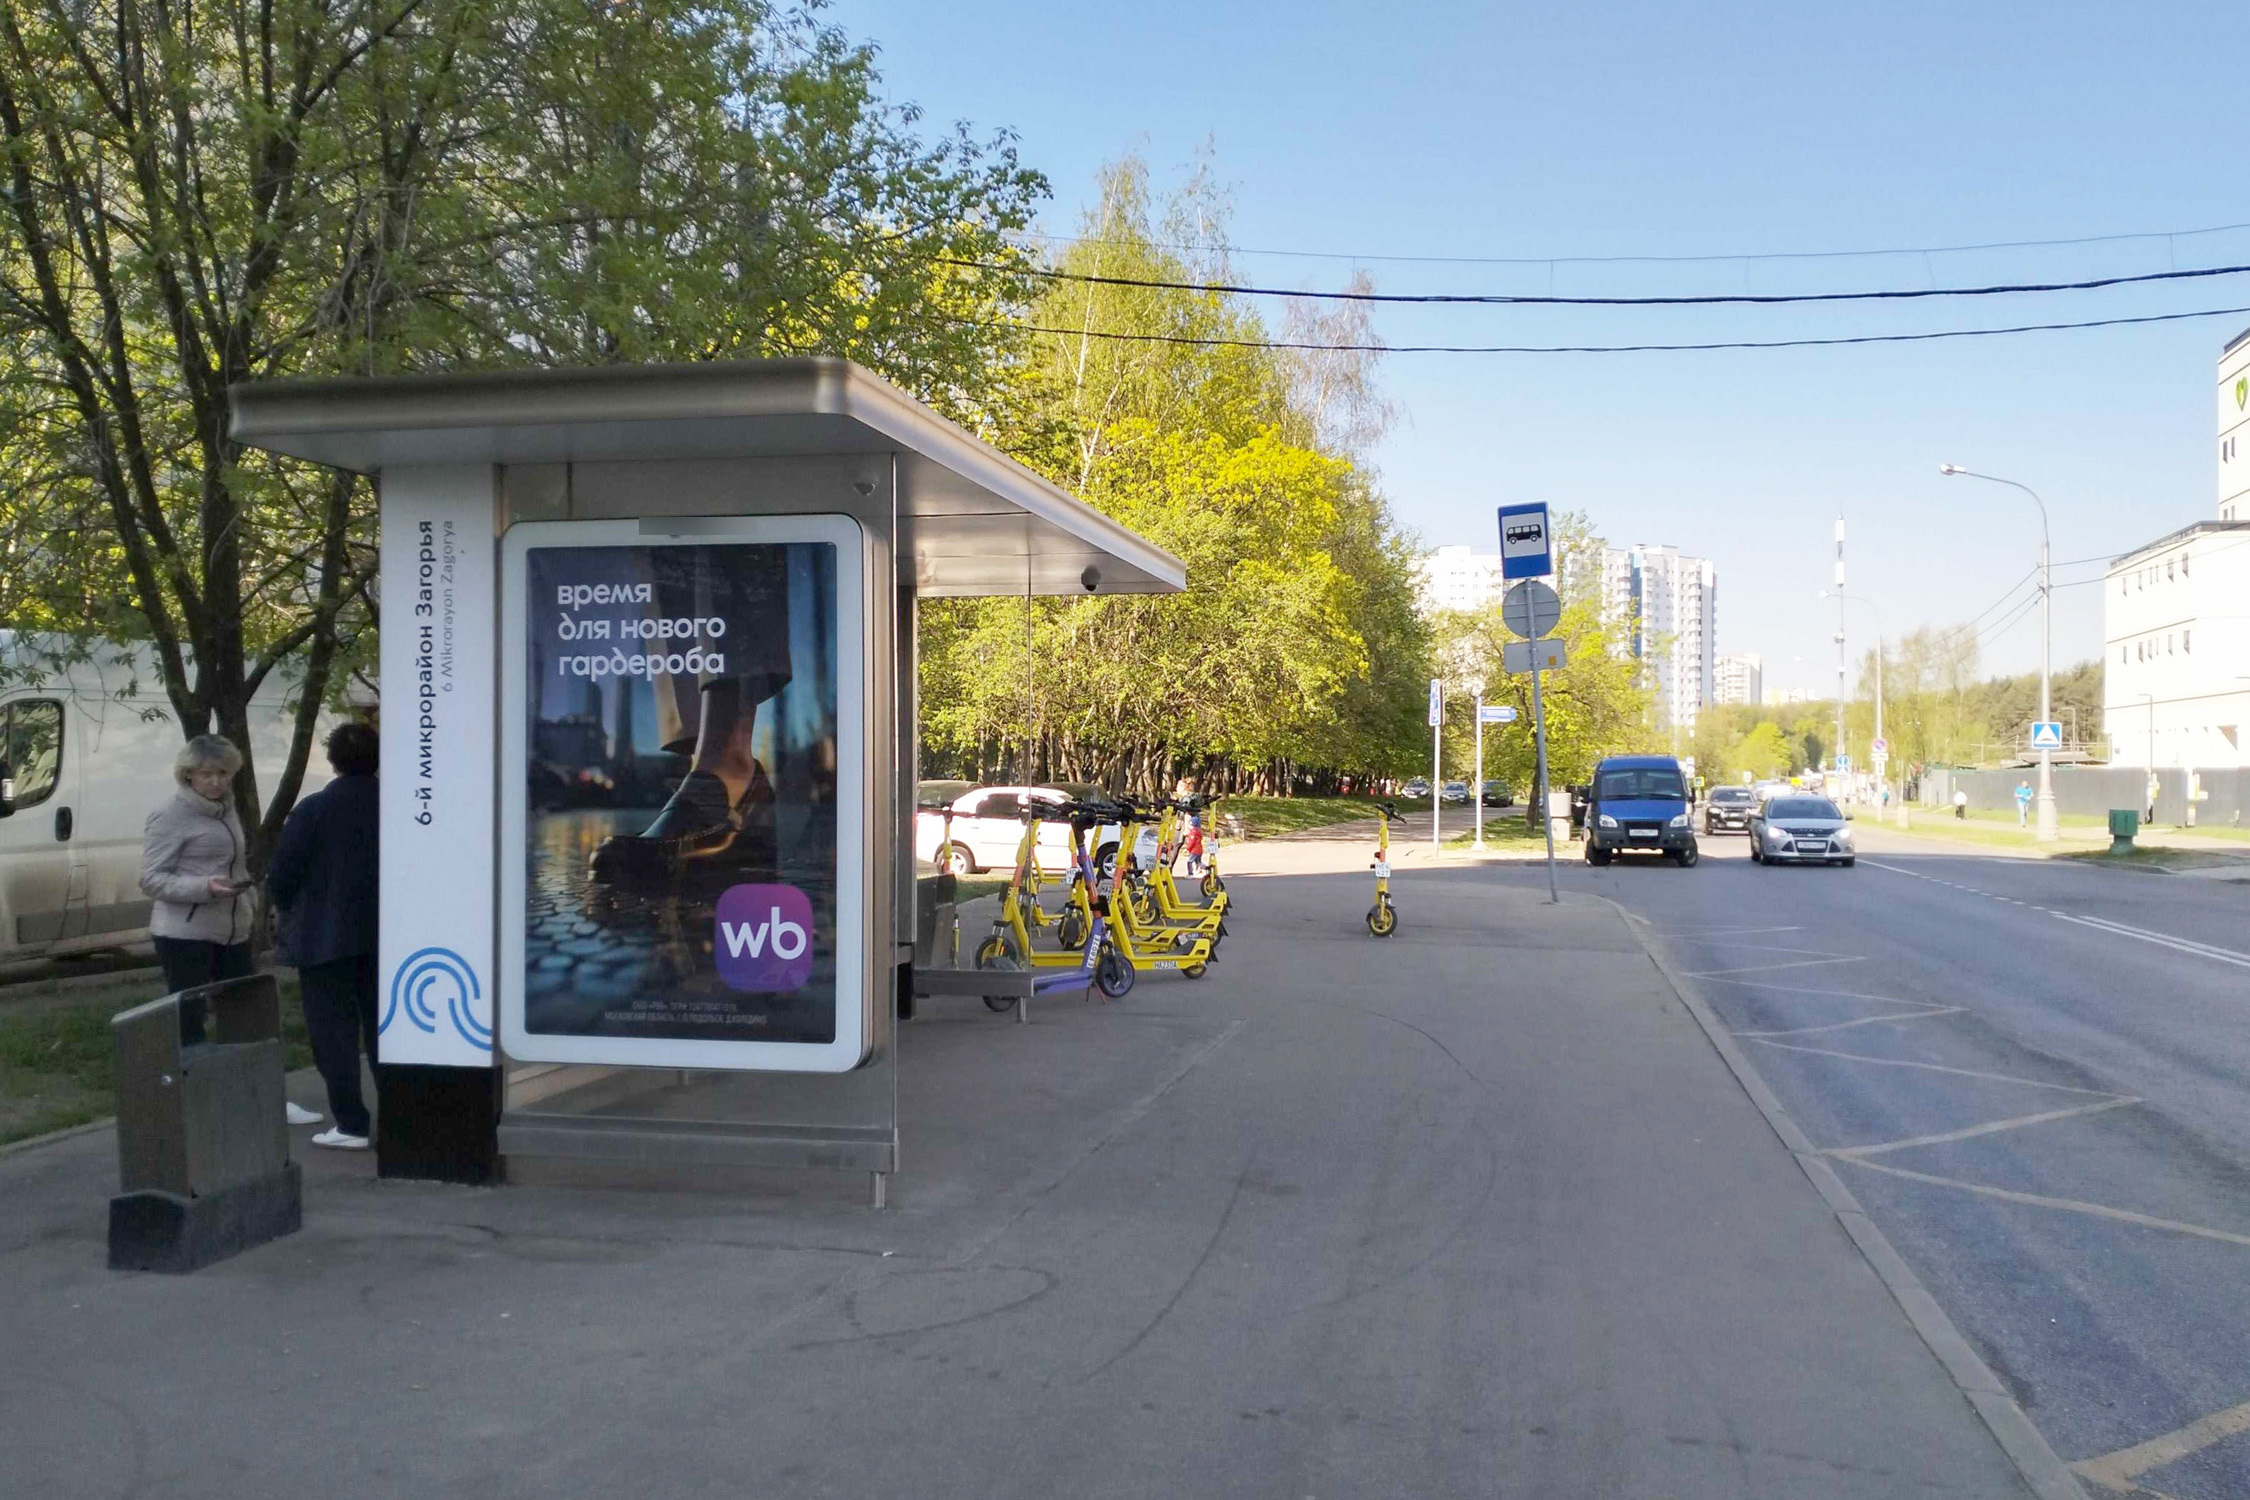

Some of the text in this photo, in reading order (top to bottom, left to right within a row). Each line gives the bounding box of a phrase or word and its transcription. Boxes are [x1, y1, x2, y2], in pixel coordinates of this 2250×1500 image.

[440, 519, 456, 693] 6 Mikrorayon Zagorya
[557, 583, 652, 611] время
[557, 612, 727, 640] для нового
[414, 520, 437, 826] 6-й микрорайон Загорья
[559, 646, 725, 682] гардероба
[721, 906, 807, 960] wb
